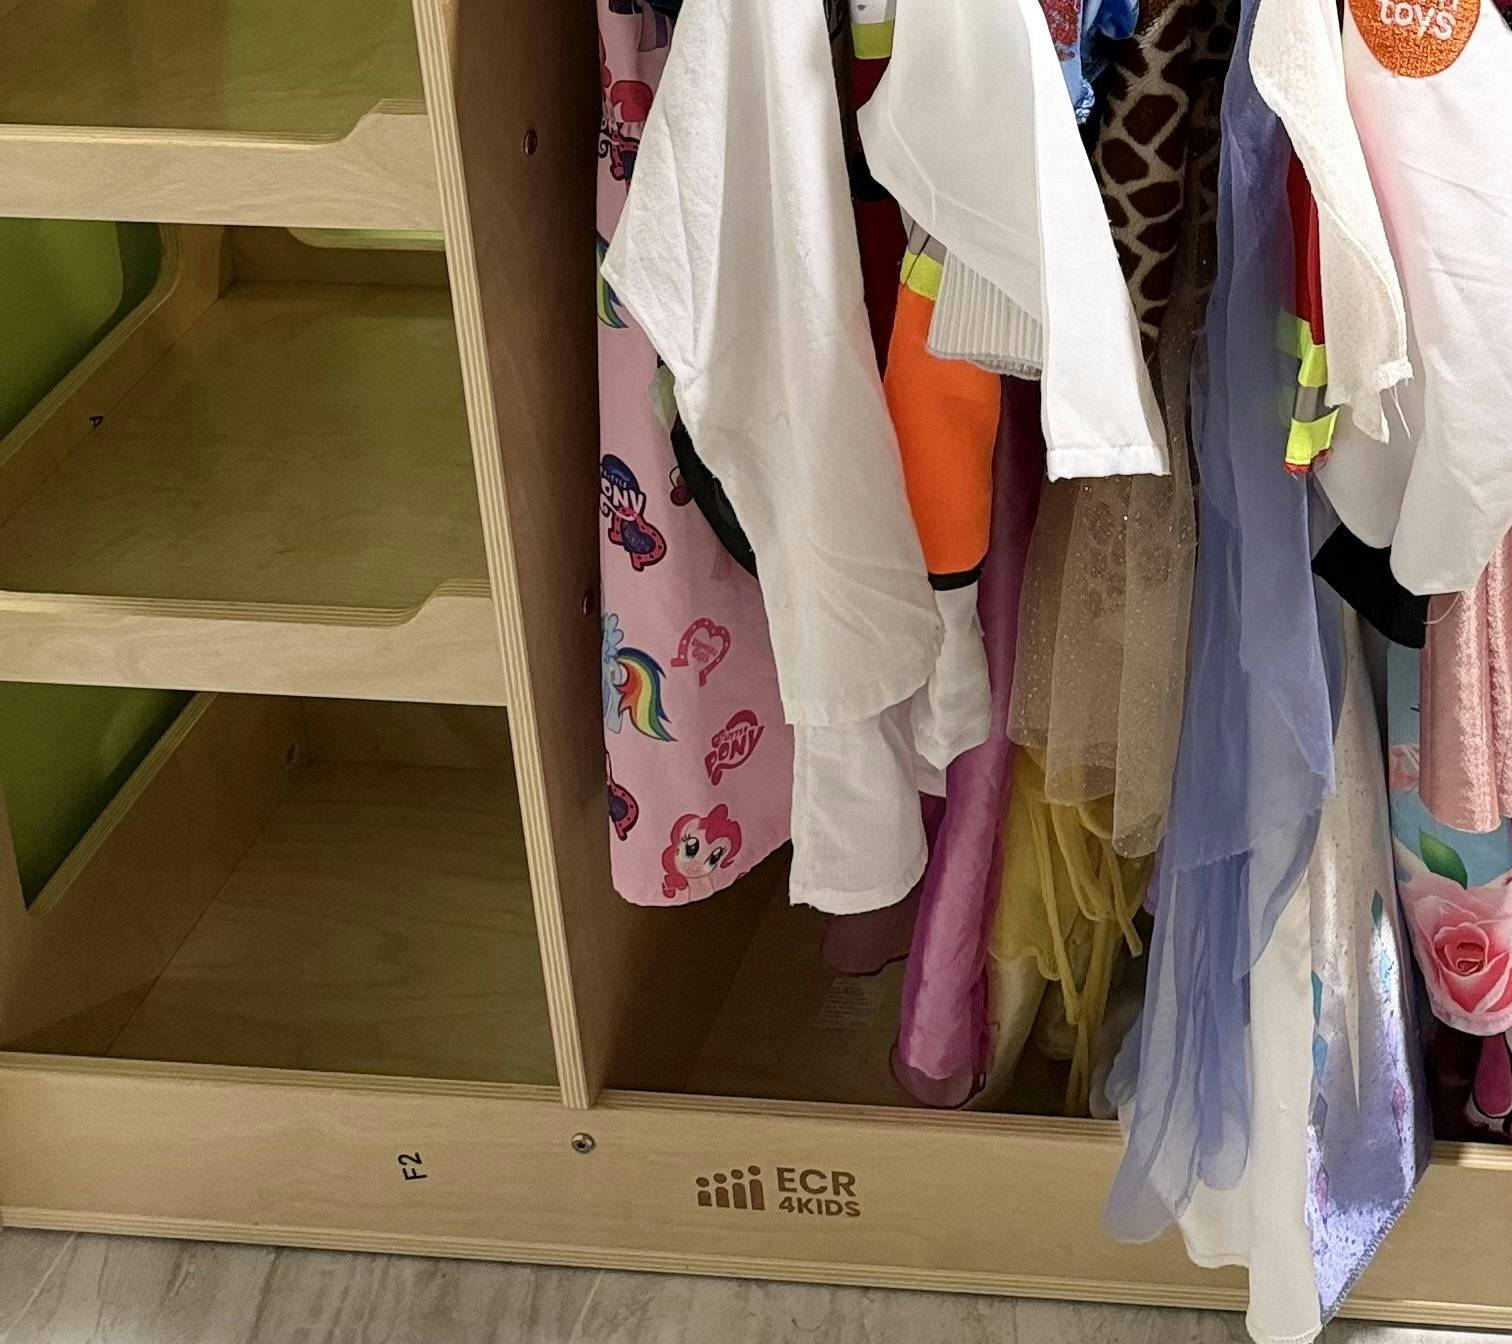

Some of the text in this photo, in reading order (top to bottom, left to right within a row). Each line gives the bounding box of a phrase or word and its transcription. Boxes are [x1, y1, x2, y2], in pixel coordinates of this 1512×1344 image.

[600, 477, 643, 521] ONY
[397, 1151, 428, 1181] F2
[776, 1166, 856, 1198] ECR
[778, 1196, 861, 1218] 4KIDS
